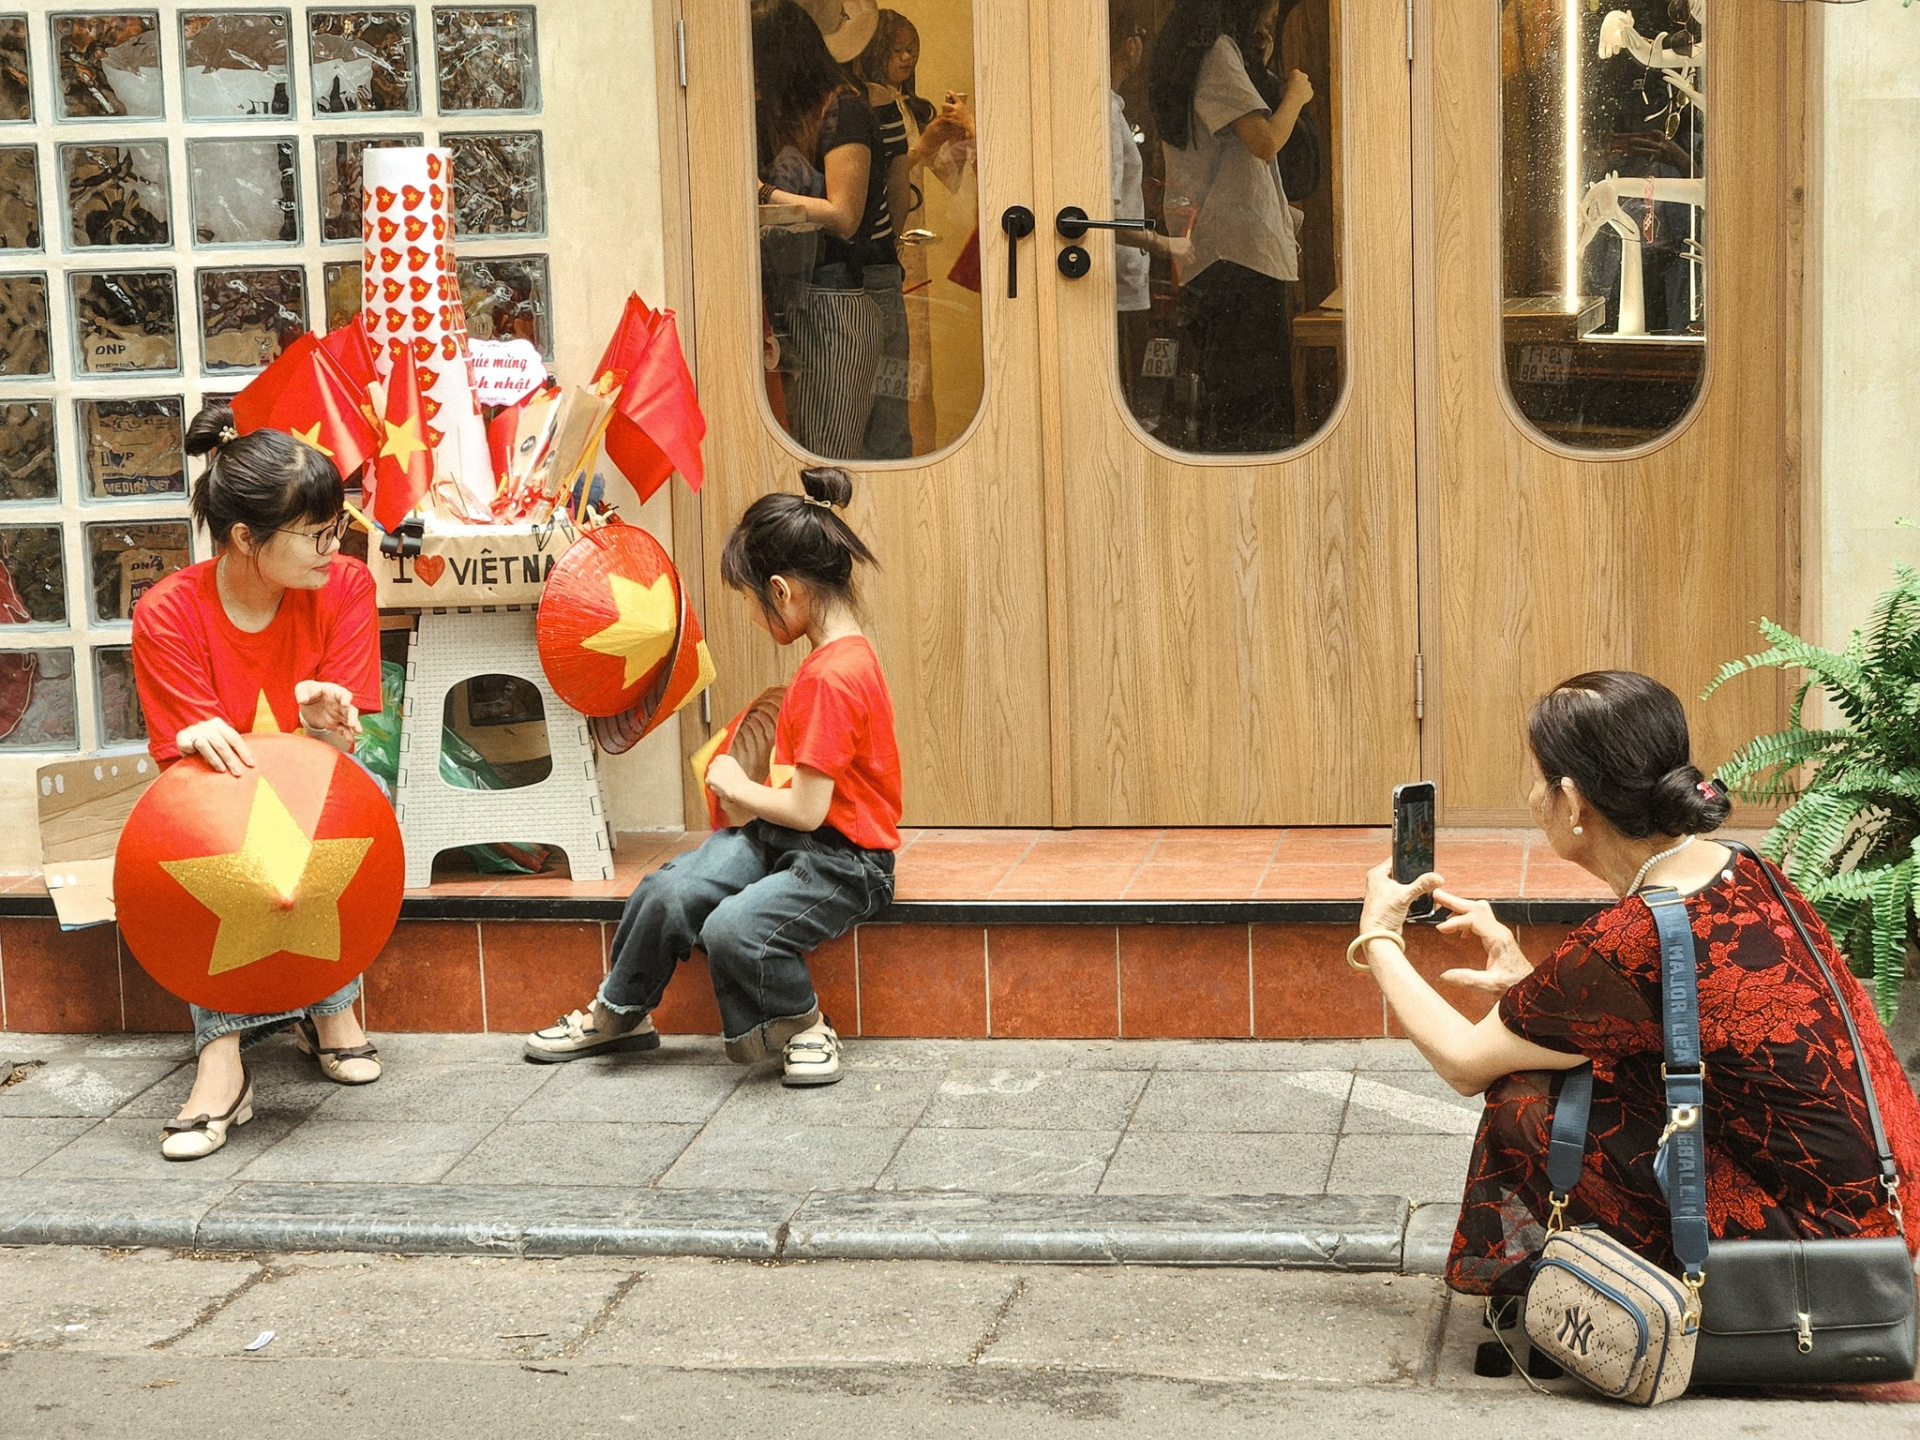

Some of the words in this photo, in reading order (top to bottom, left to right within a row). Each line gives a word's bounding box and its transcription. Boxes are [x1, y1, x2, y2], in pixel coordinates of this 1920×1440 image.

[493, 353, 527, 372] mừng
[494, 376, 531, 393] nhật
[392, 552, 413, 584] I
[1668, 943, 1688, 1014] MAJOR
[1545, 1305, 1560, 1319] NY
[1596, 1339, 1613, 1355] NY
